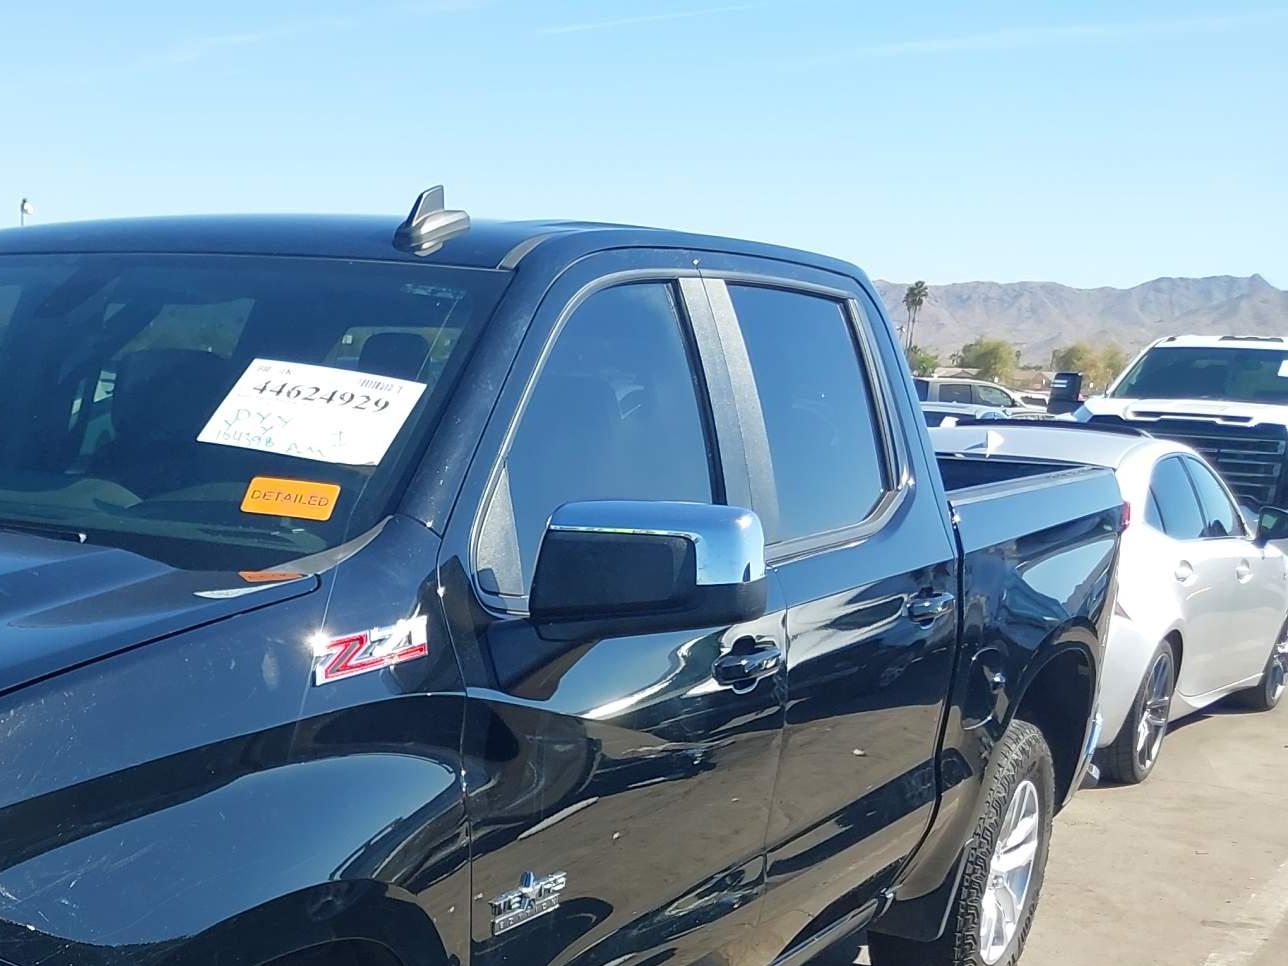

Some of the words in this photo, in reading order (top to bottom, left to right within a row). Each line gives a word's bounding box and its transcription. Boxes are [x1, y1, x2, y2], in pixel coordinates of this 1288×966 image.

[253, 379, 390, 413] 44624929
[251, 489, 329, 508] DETAILED
[315, 616, 428, 685] Z71
